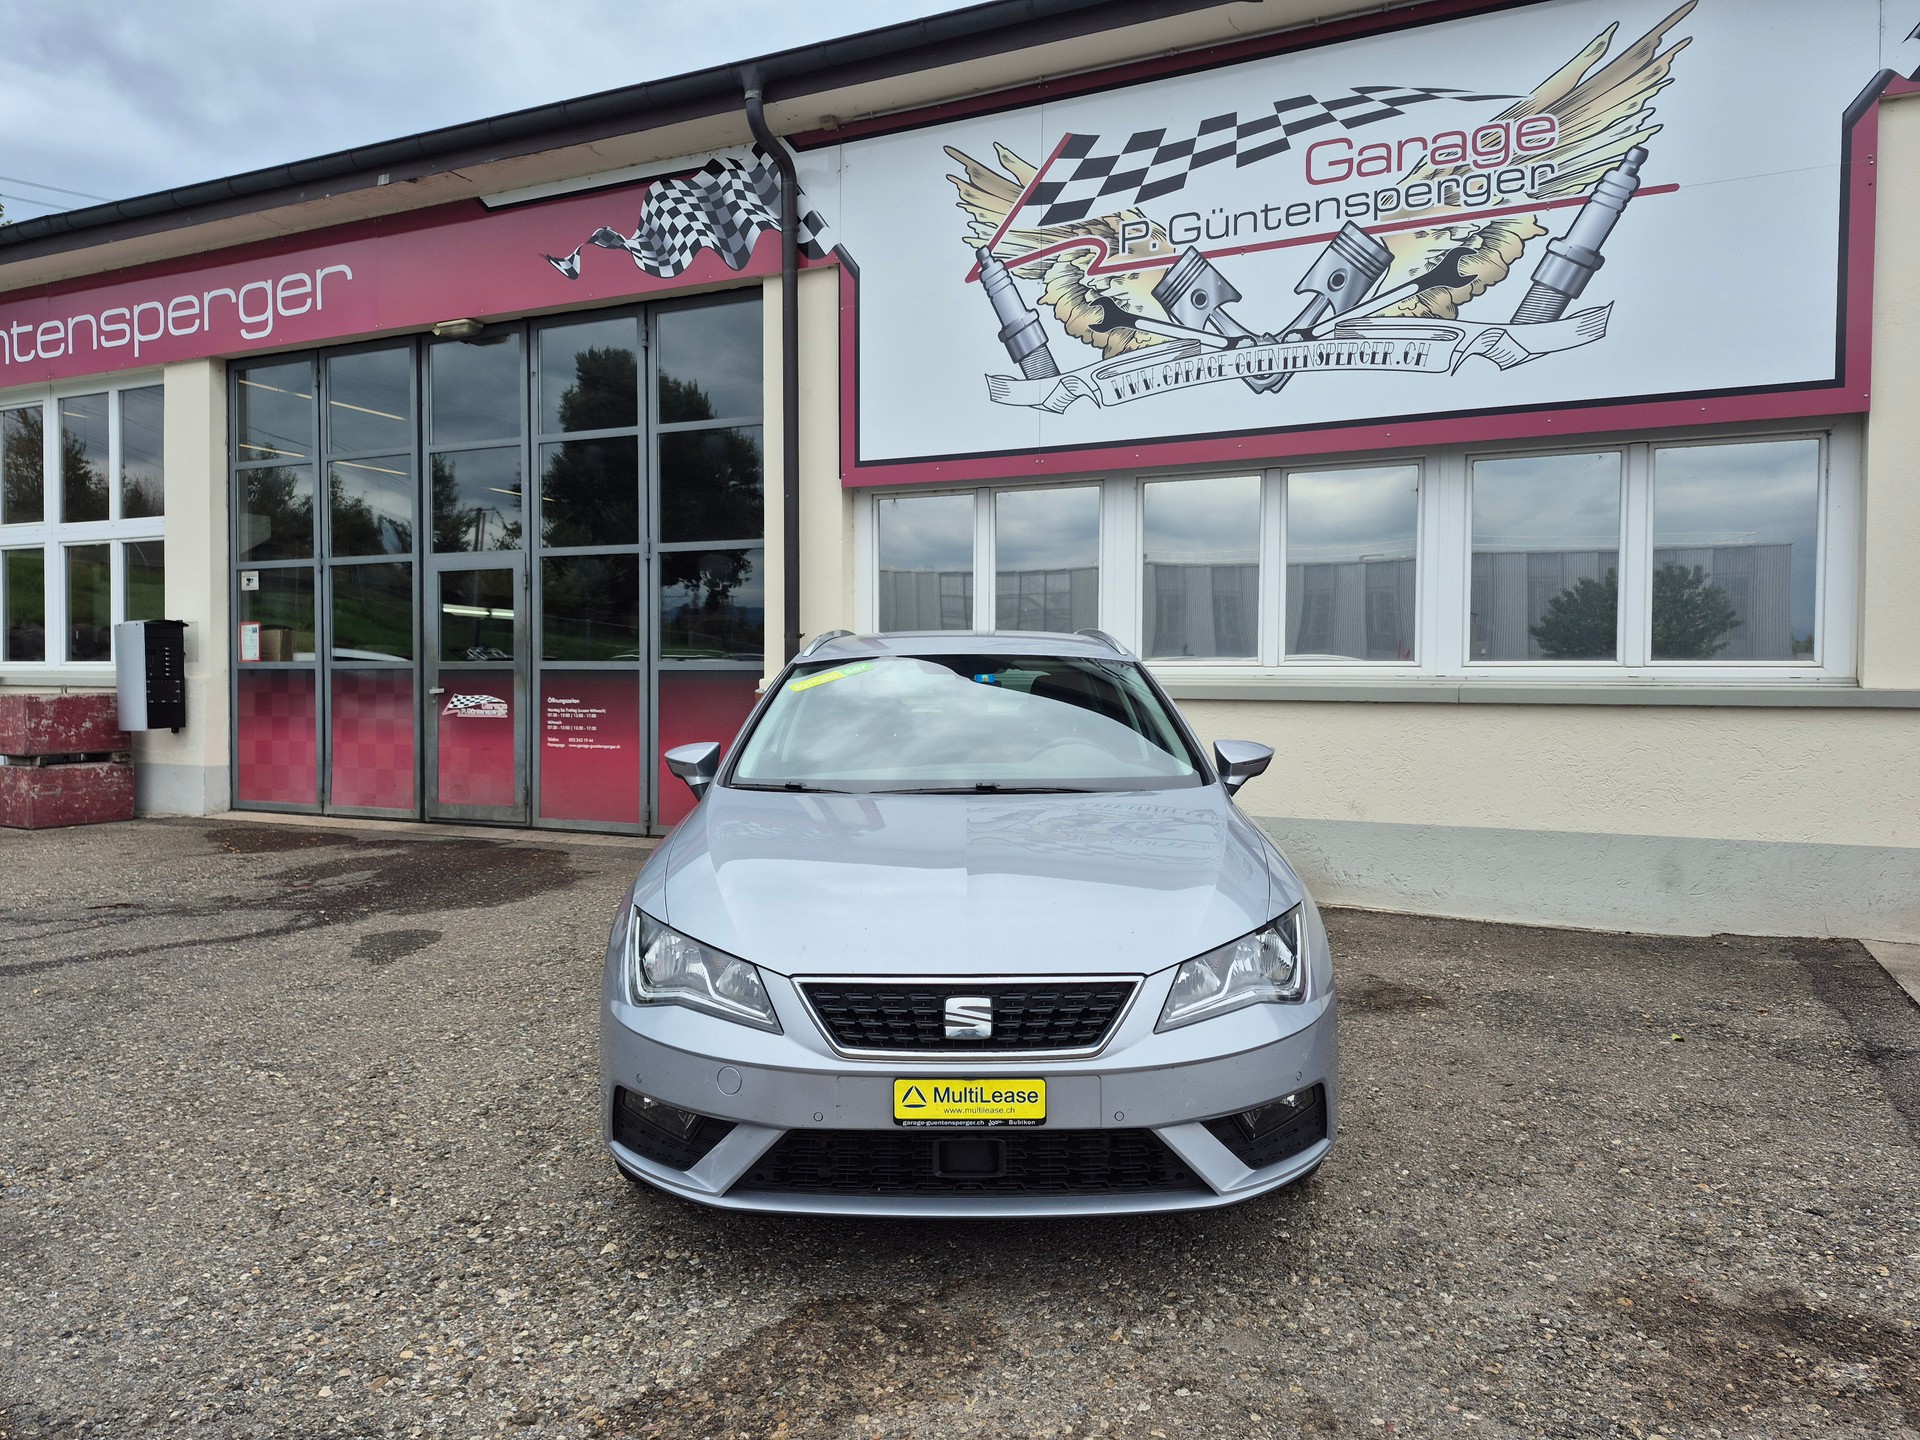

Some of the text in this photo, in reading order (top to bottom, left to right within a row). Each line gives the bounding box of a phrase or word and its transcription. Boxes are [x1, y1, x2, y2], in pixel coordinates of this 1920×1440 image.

[1305, 115, 1557, 186] Garage
[933, 1086, 1039, 1104] MultiLease
[902, 1119, 985, 1127] garage-guentensperger.ch
